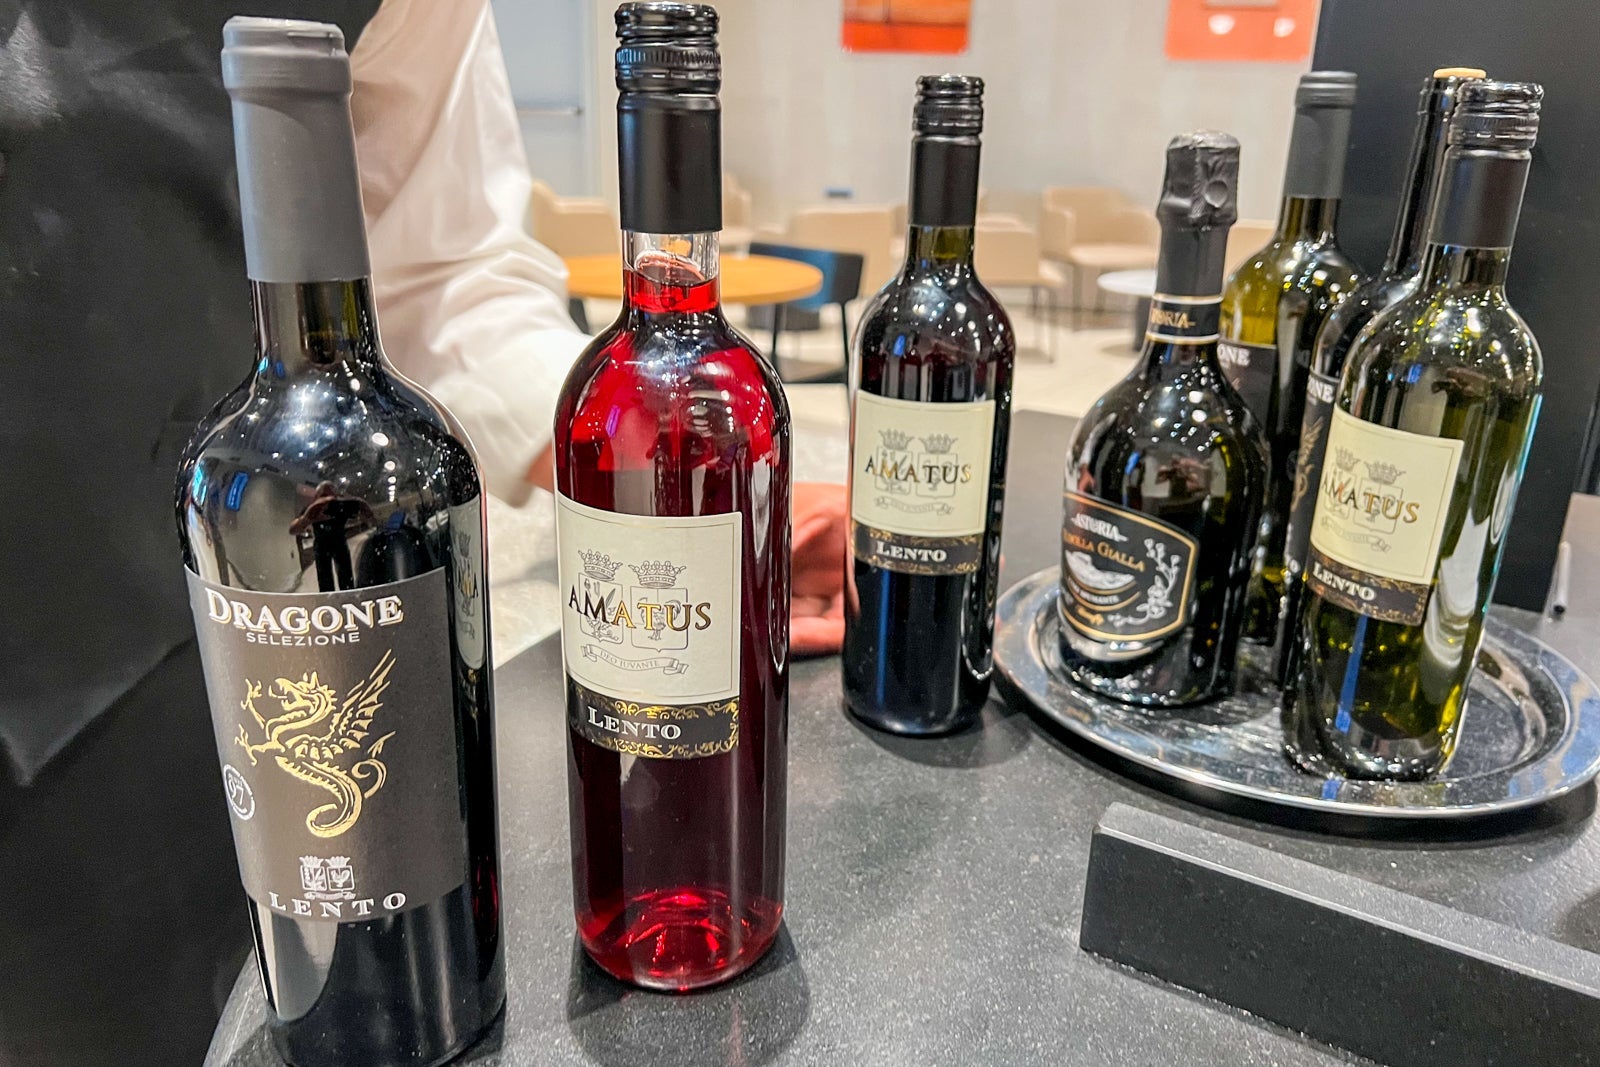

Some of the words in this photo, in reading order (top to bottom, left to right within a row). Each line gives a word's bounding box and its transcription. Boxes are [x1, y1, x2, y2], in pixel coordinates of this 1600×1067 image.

[865, 456, 972, 485] AMATUS
[1321, 470, 1420, 524] AMATUS
[876, 540, 947, 562] LENTO
[1313, 562, 1376, 600] LENTO
[205, 588, 404, 633] DRAGONE
[568, 584, 712, 632] AMATUS
[246, 631, 361, 647] SELEZIONE
[587, 705, 681, 740] LENTO
[269, 890, 407, 918] LENTO
